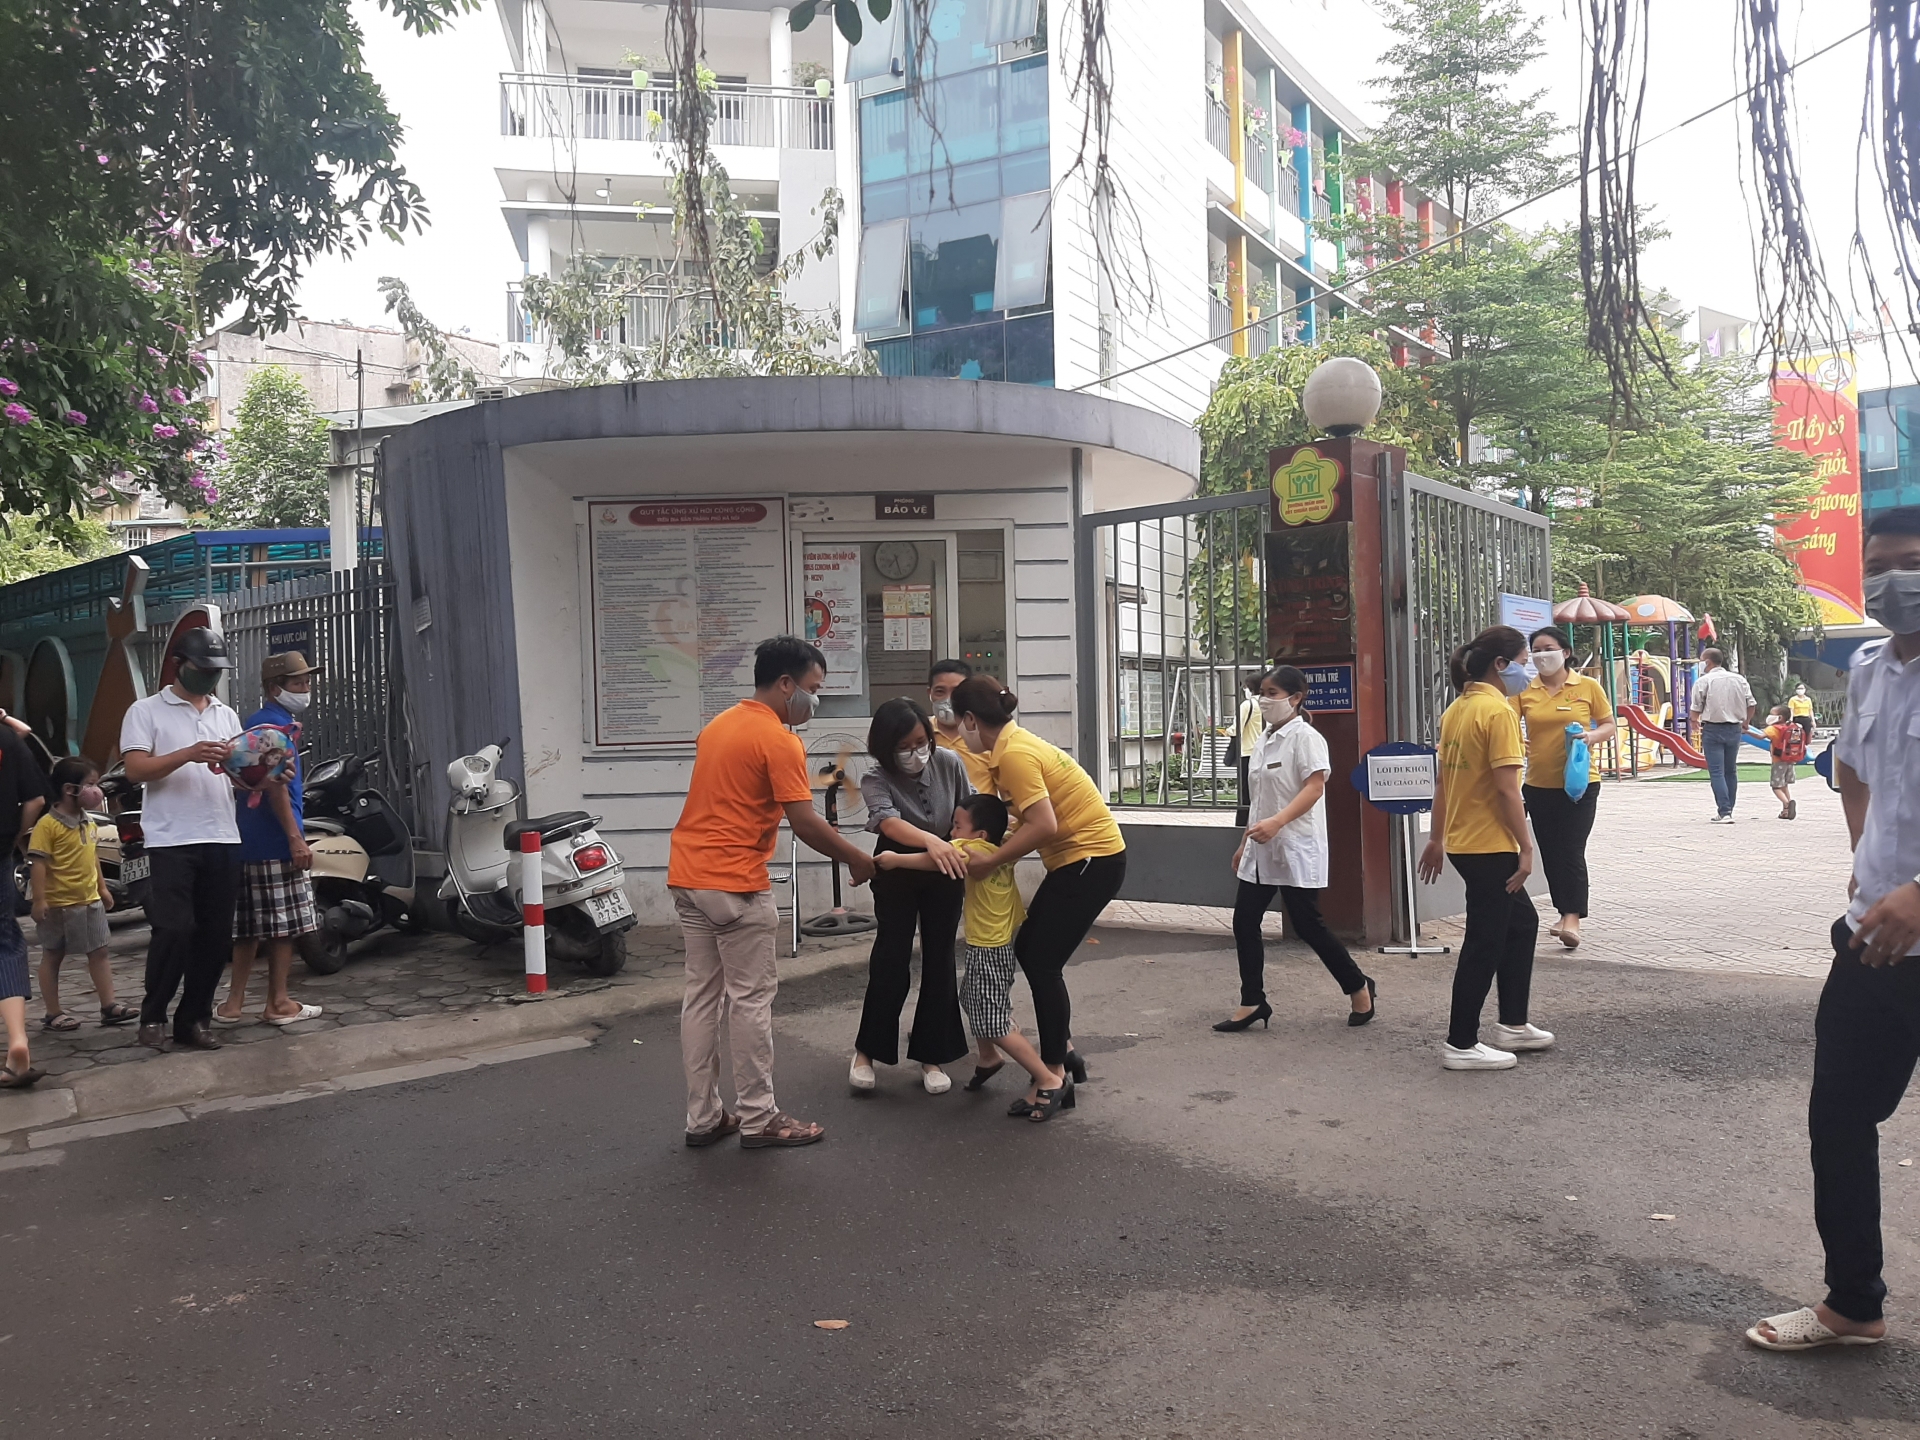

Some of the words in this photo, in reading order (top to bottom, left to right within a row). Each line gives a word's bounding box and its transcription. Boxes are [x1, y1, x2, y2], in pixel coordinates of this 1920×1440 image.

[1787, 414, 1825, 446] Thầy
[1828, 414, 1845, 436] cô
[884, 504, 908, 514] BẢO
[912, 506, 928, 515] VỆ
[1810, 492, 1858, 520] gương
[592, 892, 620, 911] 30-L9
